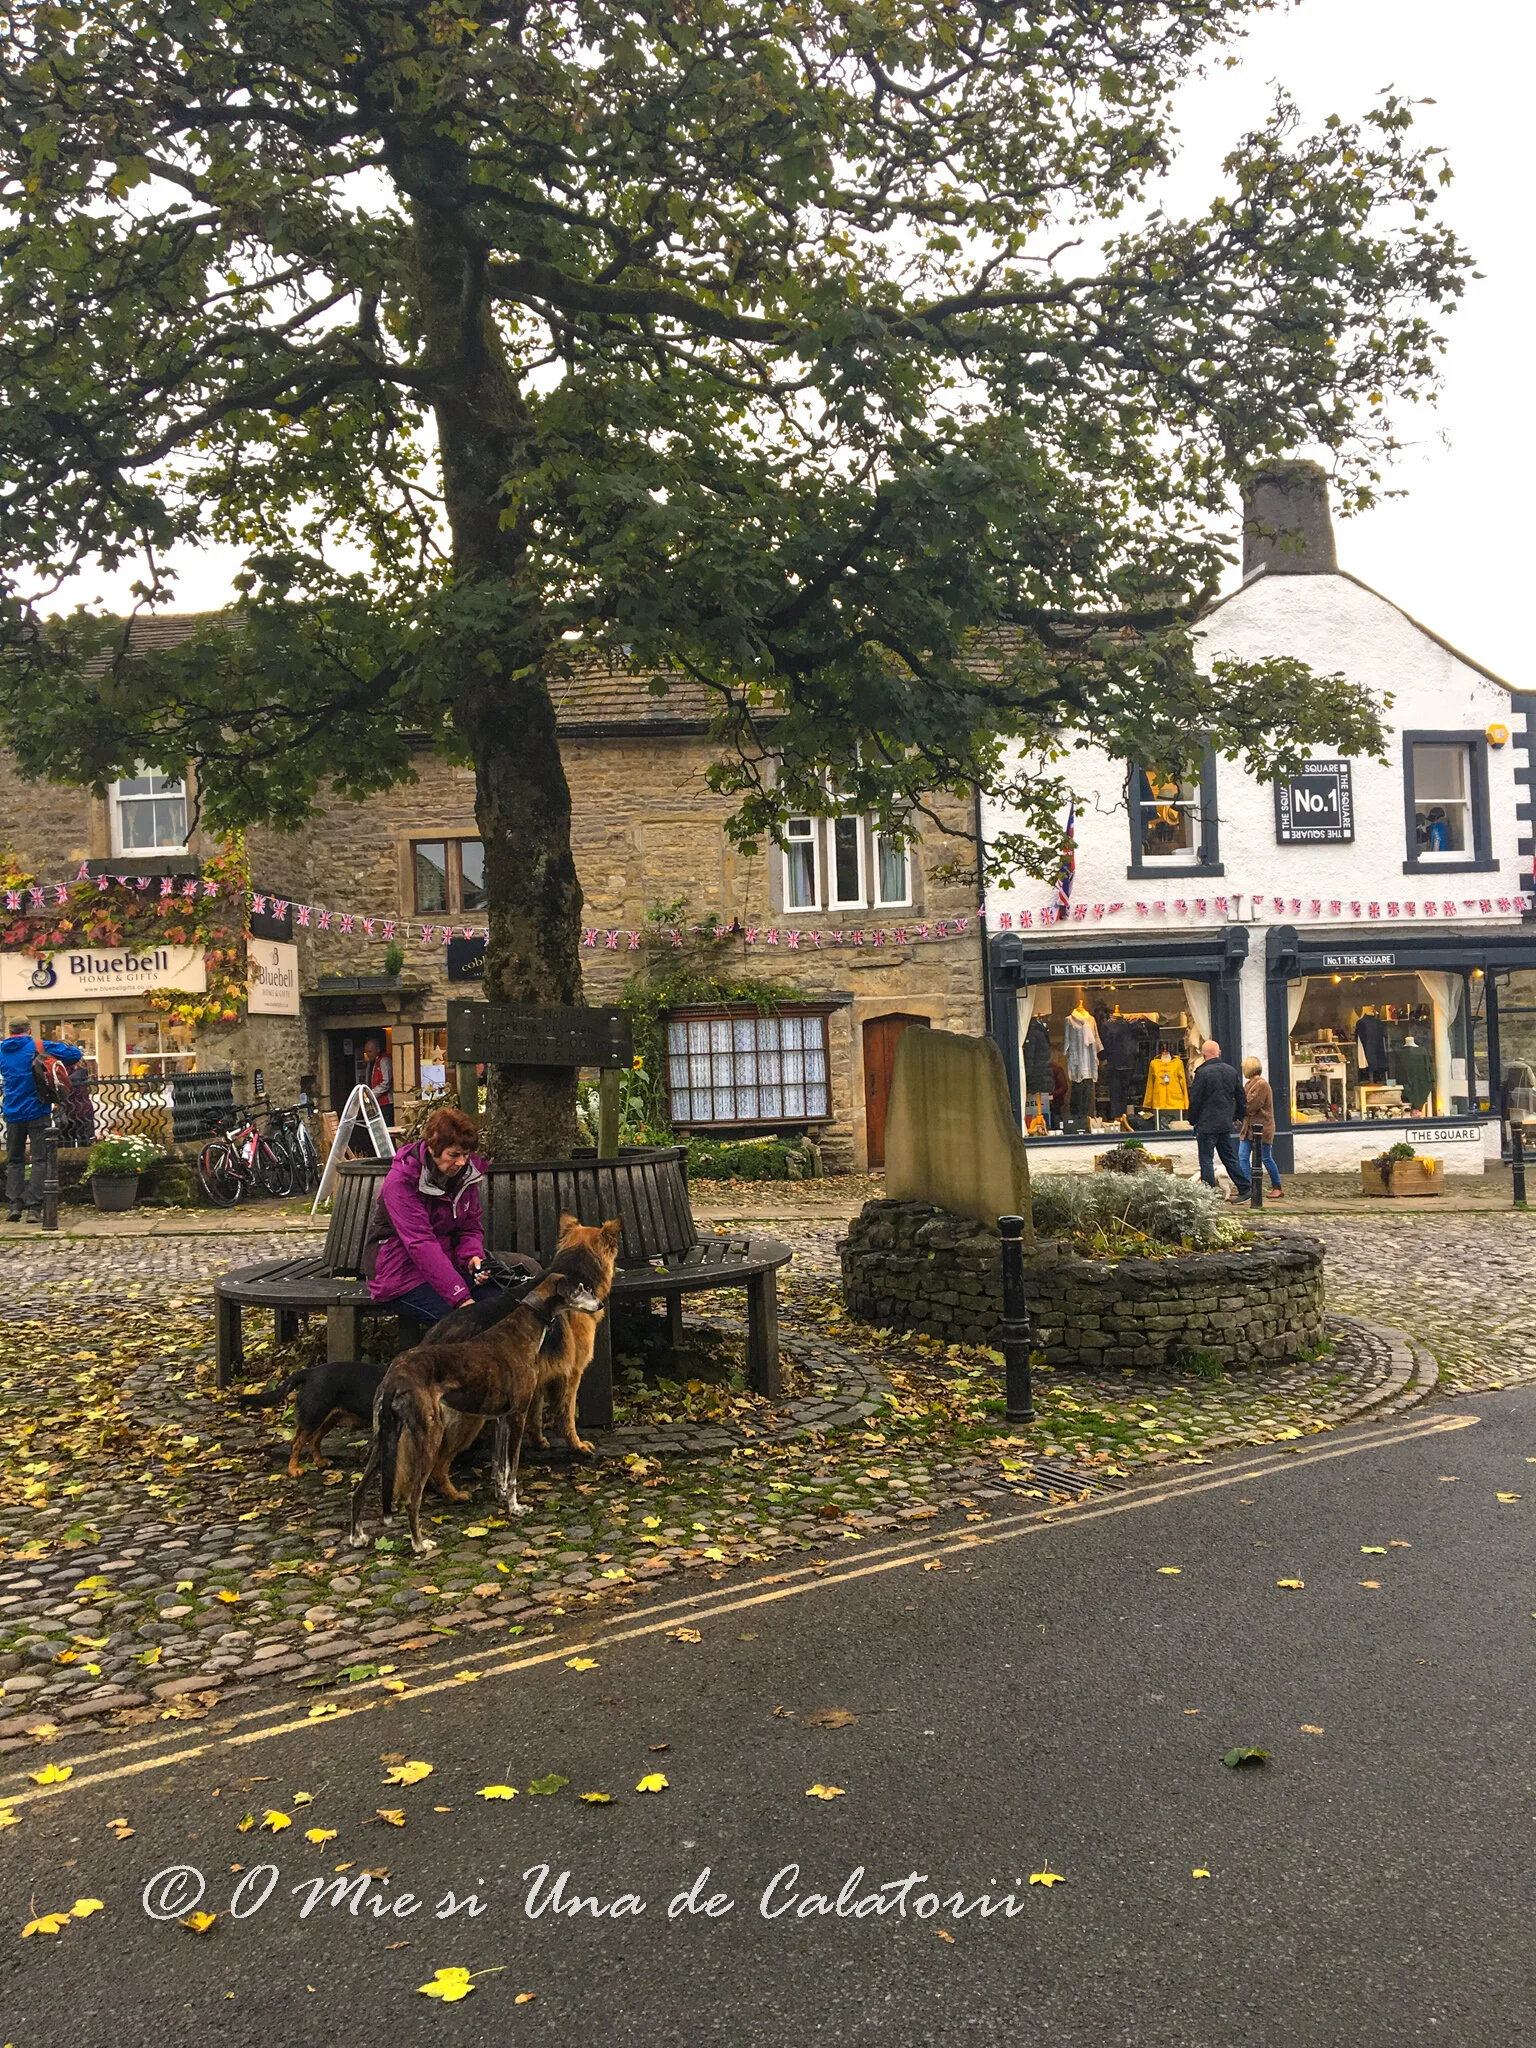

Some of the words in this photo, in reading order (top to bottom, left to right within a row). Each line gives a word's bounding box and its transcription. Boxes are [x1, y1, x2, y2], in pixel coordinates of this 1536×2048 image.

[1305, 764, 1339, 772] SQUARE
[1341, 774, 1349, 790] THE
[1280, 784, 1289, 811] SQUA
[1295, 788, 1338, 812] No.1
[1341, 791, 1351, 828] SQUARE
[1291, 829, 1325, 838] SQUARE
[1328, 829, 1342, 838] THE
[69, 951, 168, 975] Bluebell
[1327, 956, 1341, 965] No.1
[1343, 956, 1357, 964] THE
[1359, 955, 1391, 964] SQUARE
[1054, 965, 1069, 974] No.1
[1072, 965, 1086, 973] THE
[1088, 963, 1121, 973] SQUARE
[79, 974, 111, 984] HOME
[116, 974, 123, 982] &
[126, 973, 159, 982] GIFTS
[260, 966, 294, 988] Bluebell
[1412, 1131, 1432, 1141] THE
[1434, 1129, 1475, 1140] SQUARE
